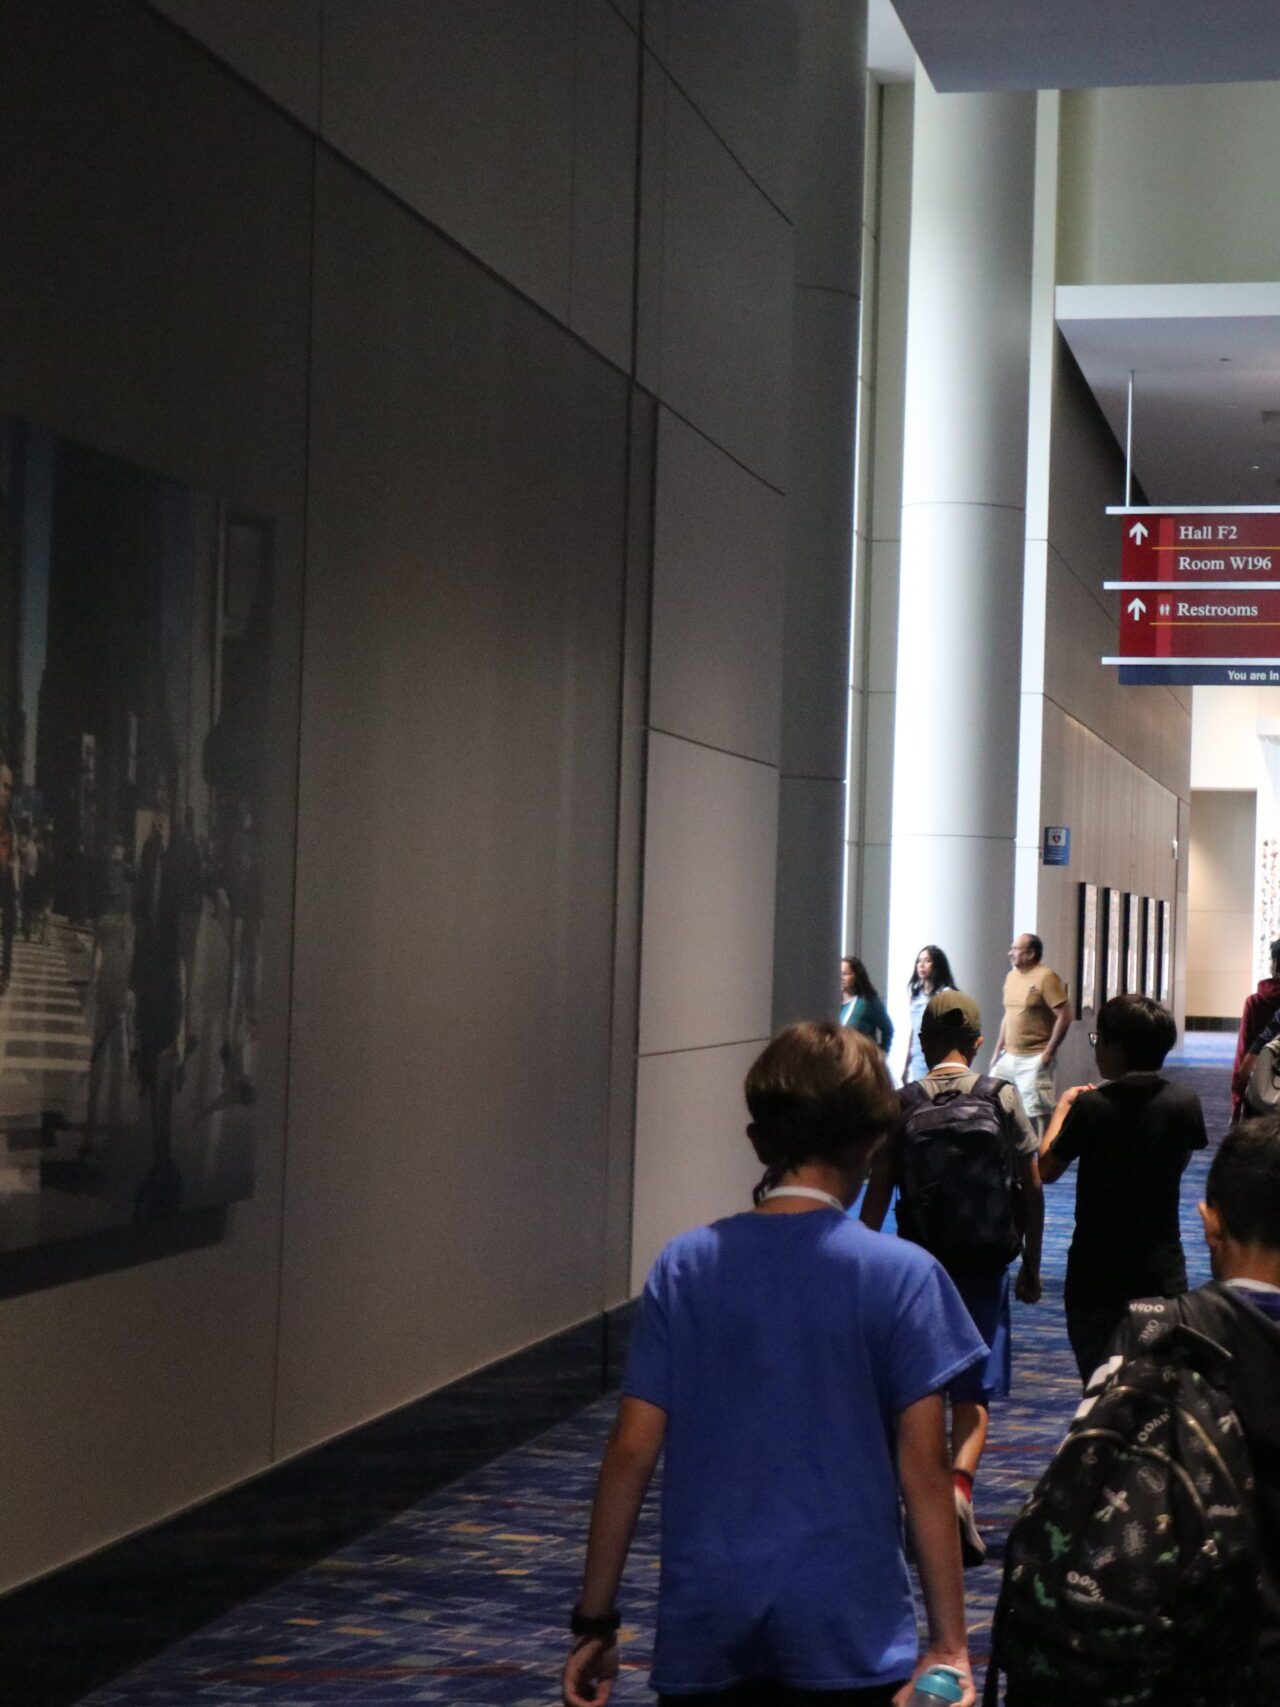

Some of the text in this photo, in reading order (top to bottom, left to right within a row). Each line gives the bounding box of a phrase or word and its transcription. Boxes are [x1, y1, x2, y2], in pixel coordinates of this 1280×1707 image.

[1179, 525, 1238, 540] Hall F2
[1178, 556, 1272, 570] Room W196
[1177, 602, 1258, 617] Restrooms
[1228, 670, 1247, 681] You
[1249, 671, 1267, 681] are
[1269, 670, 1280, 681] in
